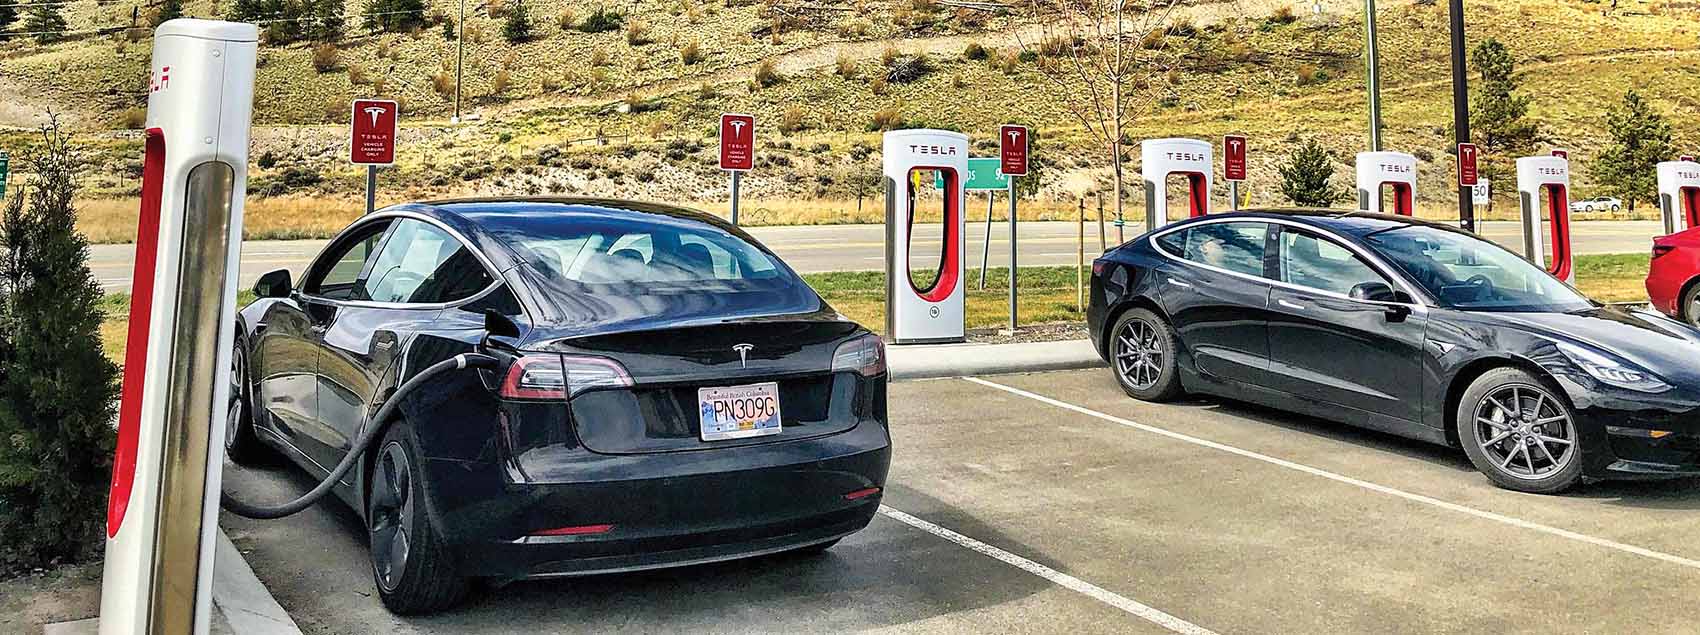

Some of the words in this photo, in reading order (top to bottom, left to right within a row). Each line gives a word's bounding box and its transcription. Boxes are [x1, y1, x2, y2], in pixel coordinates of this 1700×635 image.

[910, 145, 956, 155] TESLA
[1167, 152, 1204, 161] TESLA
[1380, 164, 1410, 172] TESLA
[1538, 167, 1565, 175] TESLA
[1473, 185, 1487, 197] 50
[714, 397, 775, 422] PN309G
